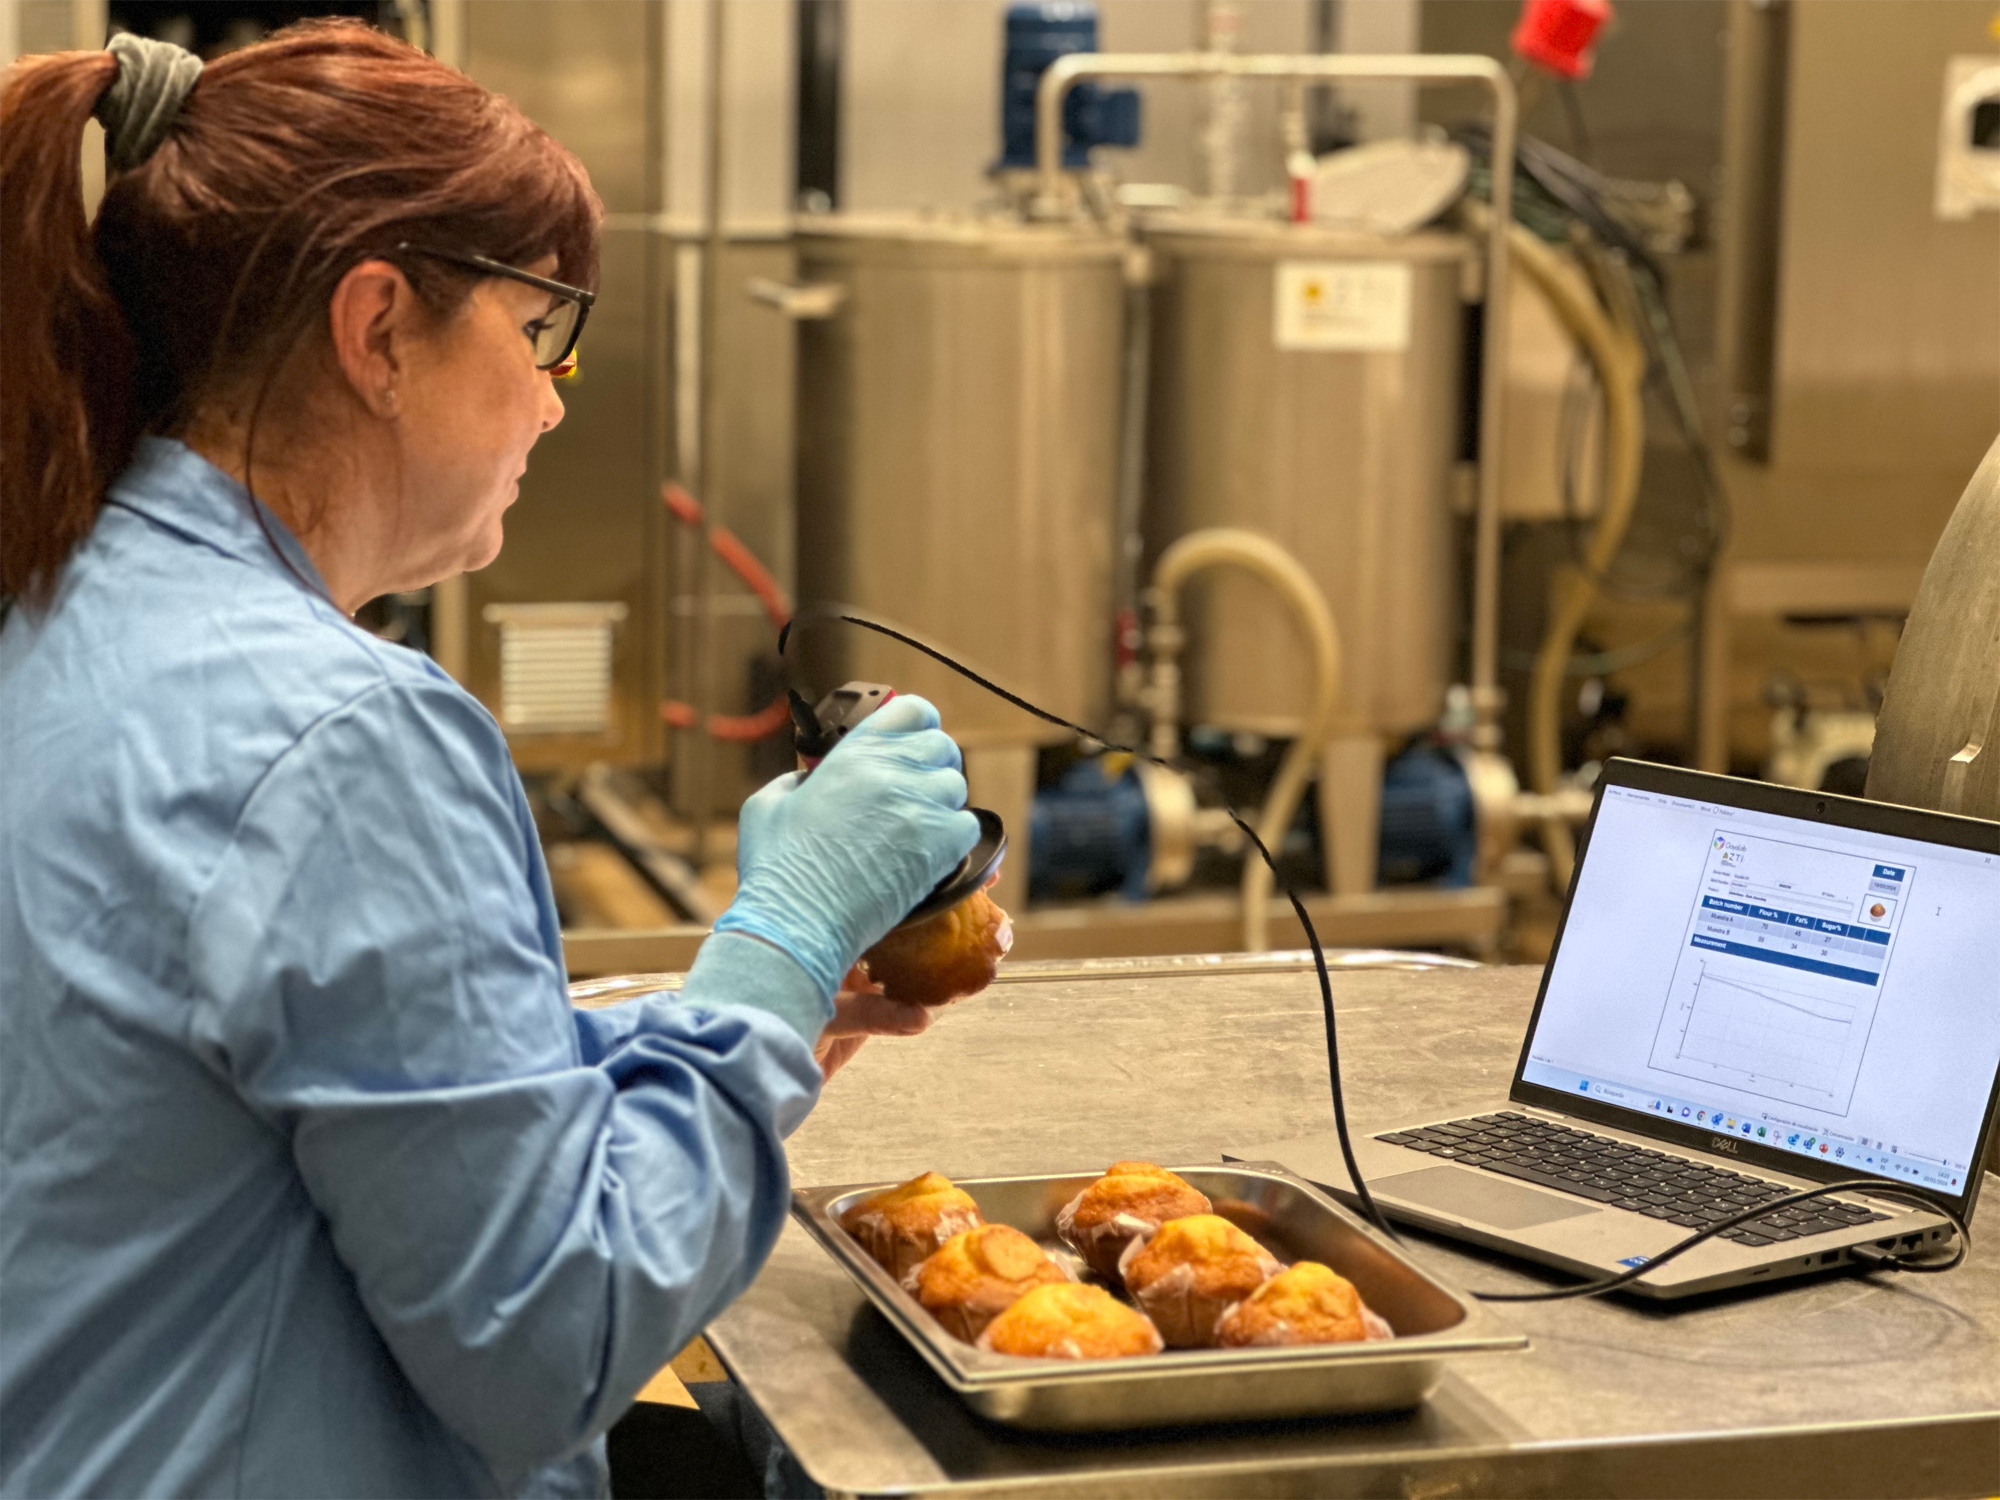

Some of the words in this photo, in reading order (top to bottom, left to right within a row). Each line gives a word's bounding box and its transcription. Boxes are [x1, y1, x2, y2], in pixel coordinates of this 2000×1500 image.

[1882, 868, 1896, 876] Date
[1708, 898, 1723, 907] Batch
[1724, 901, 1743, 911] number
[1710, 913, 1729, 921] Muestra
[1759, 909, 1772, 917] Flour
[1707, 926, 1725, 934] Muestra
[1694, 936, 1726, 949] Measurement
[1711, 1137, 1738, 1154] DELL
